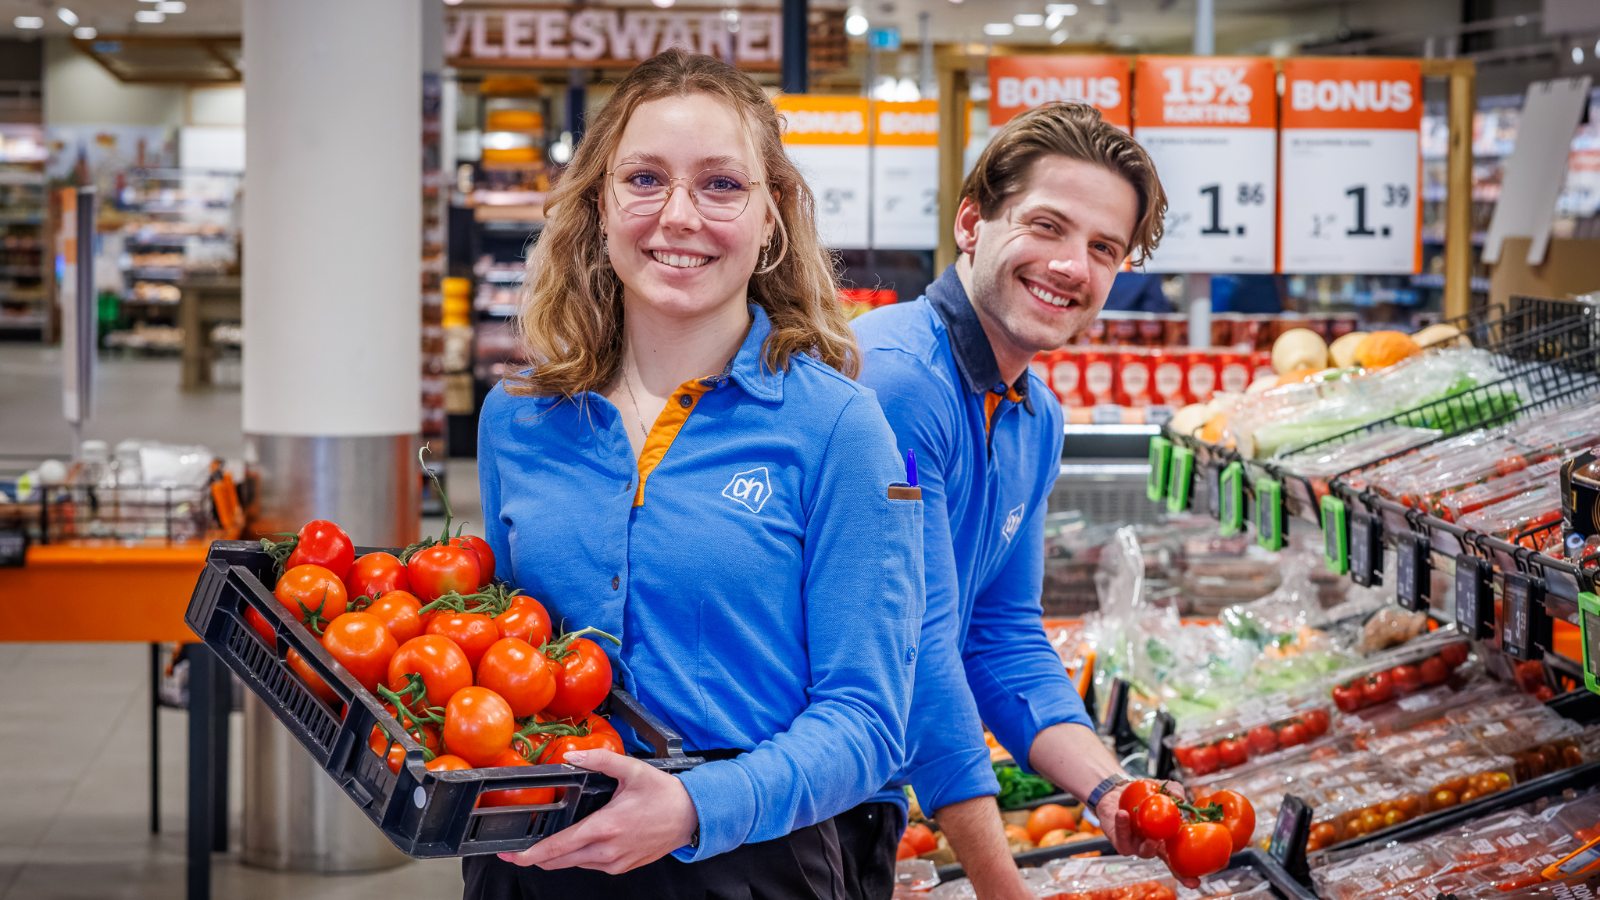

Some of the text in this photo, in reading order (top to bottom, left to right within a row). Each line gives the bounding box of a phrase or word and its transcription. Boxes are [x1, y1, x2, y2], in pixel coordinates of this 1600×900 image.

[997, 77, 1121, 109] BONUS
[1162, 67, 1252, 104] 15%
[1291, 79, 1413, 112] BONUS
